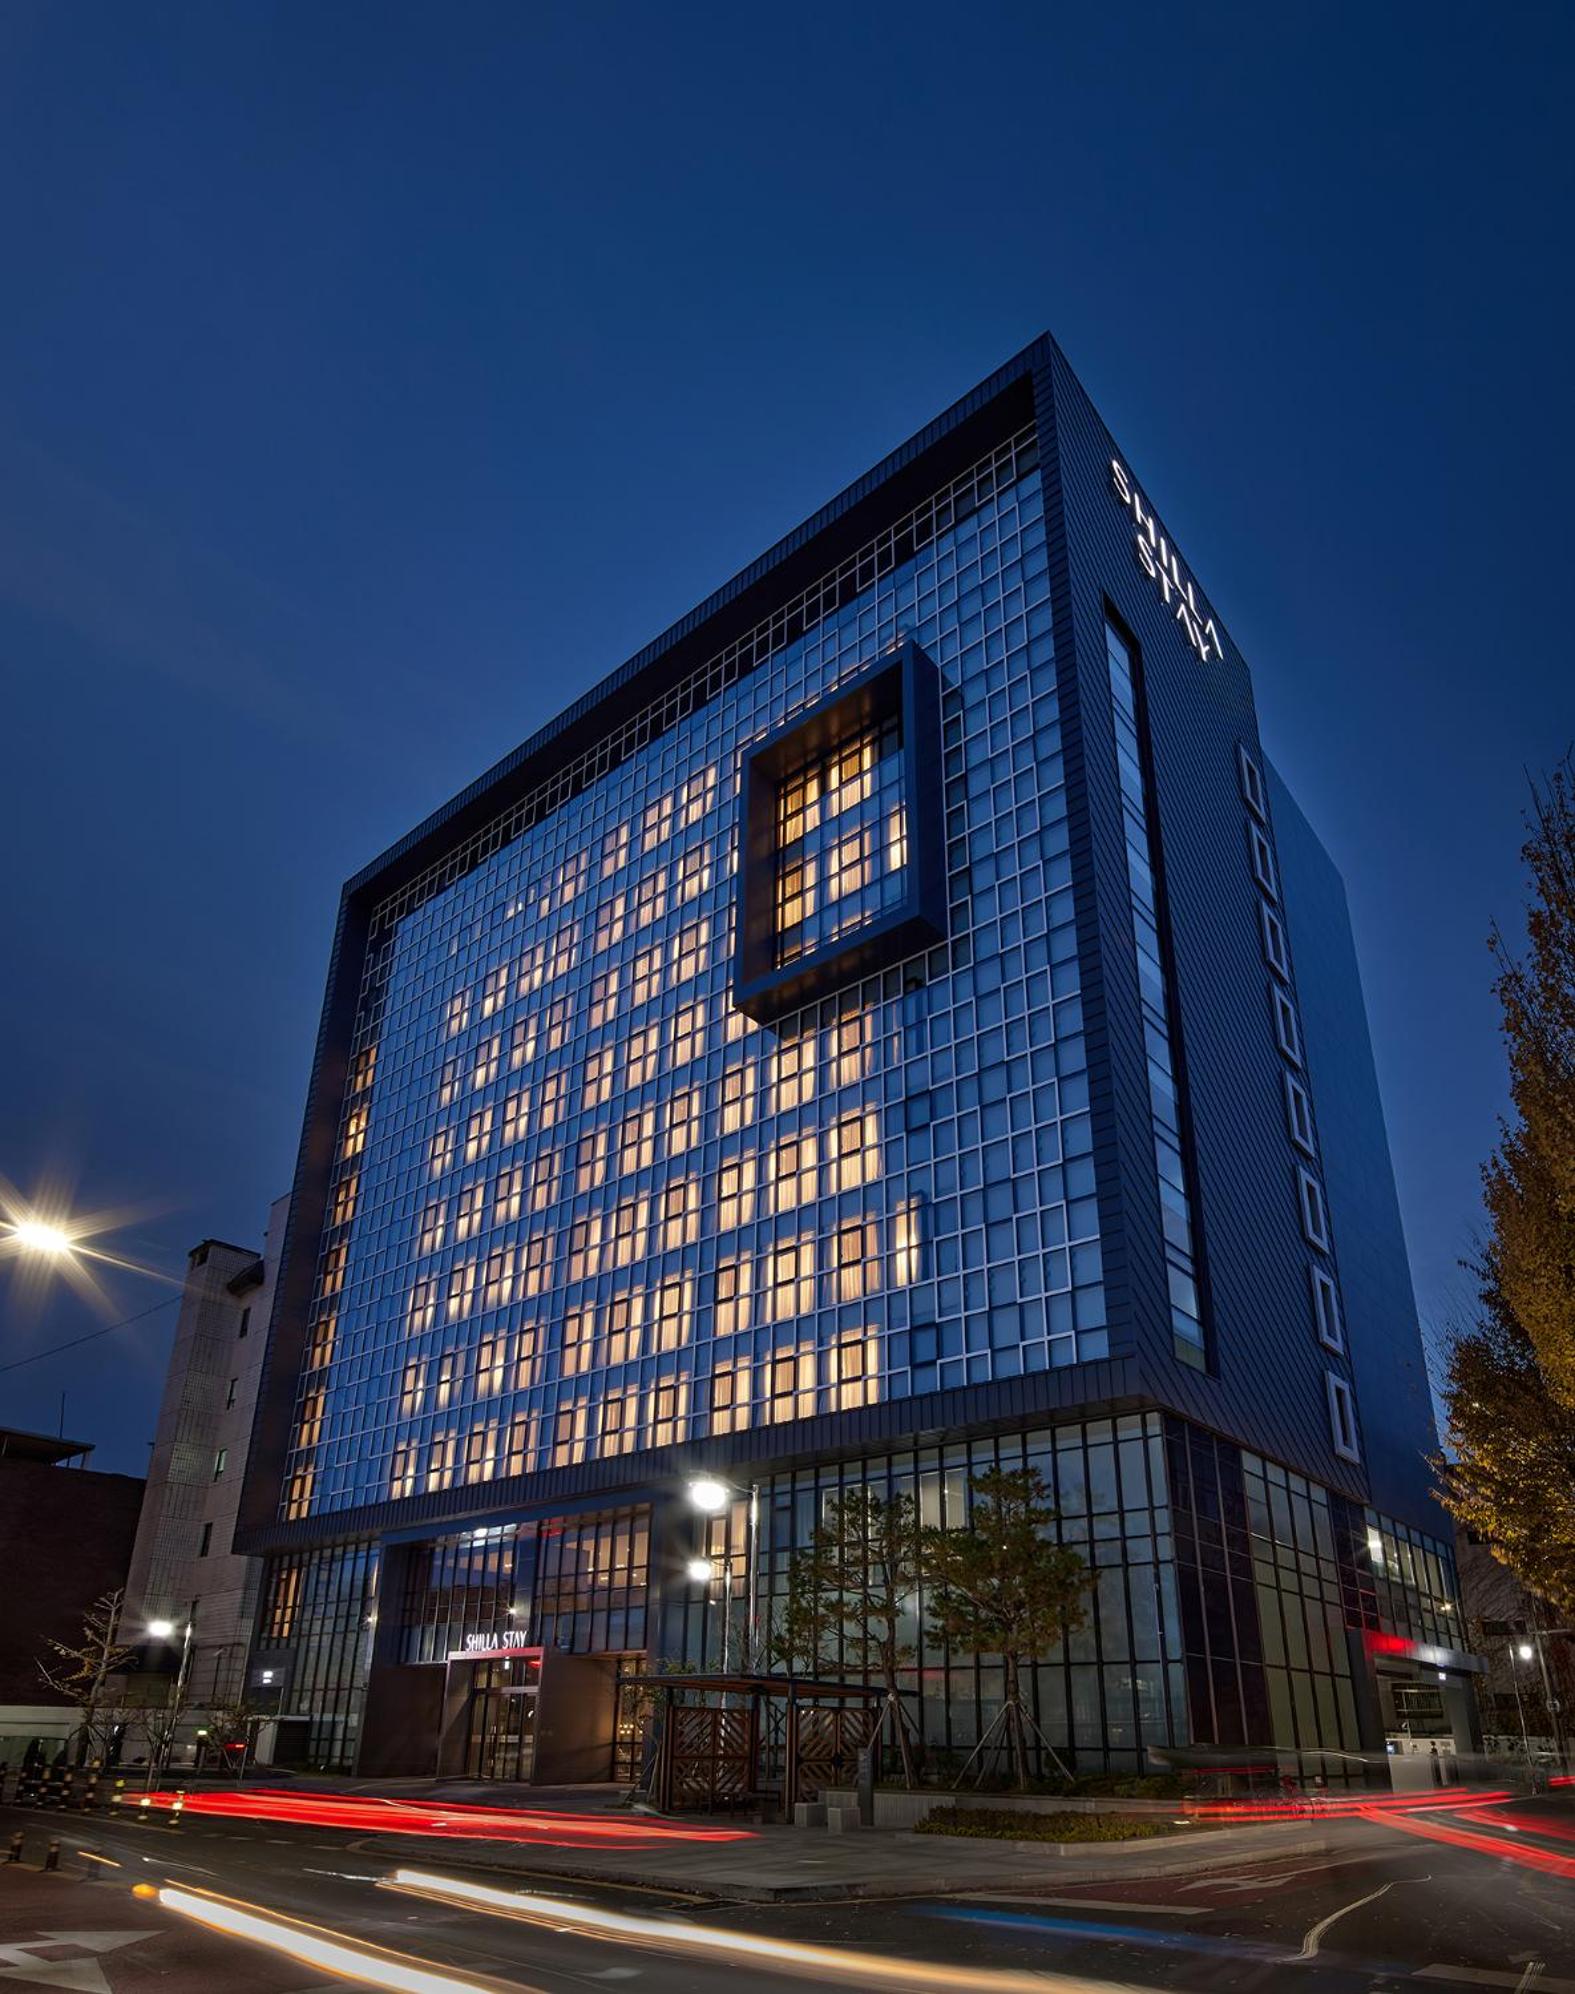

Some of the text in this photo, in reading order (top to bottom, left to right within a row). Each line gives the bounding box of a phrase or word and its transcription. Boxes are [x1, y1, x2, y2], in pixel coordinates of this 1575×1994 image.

[1112, 459, 1224, 660] SHILLA
[1137, 534, 1210, 662] STAY
[465, 1630, 527, 1652] SHILLA STAY
